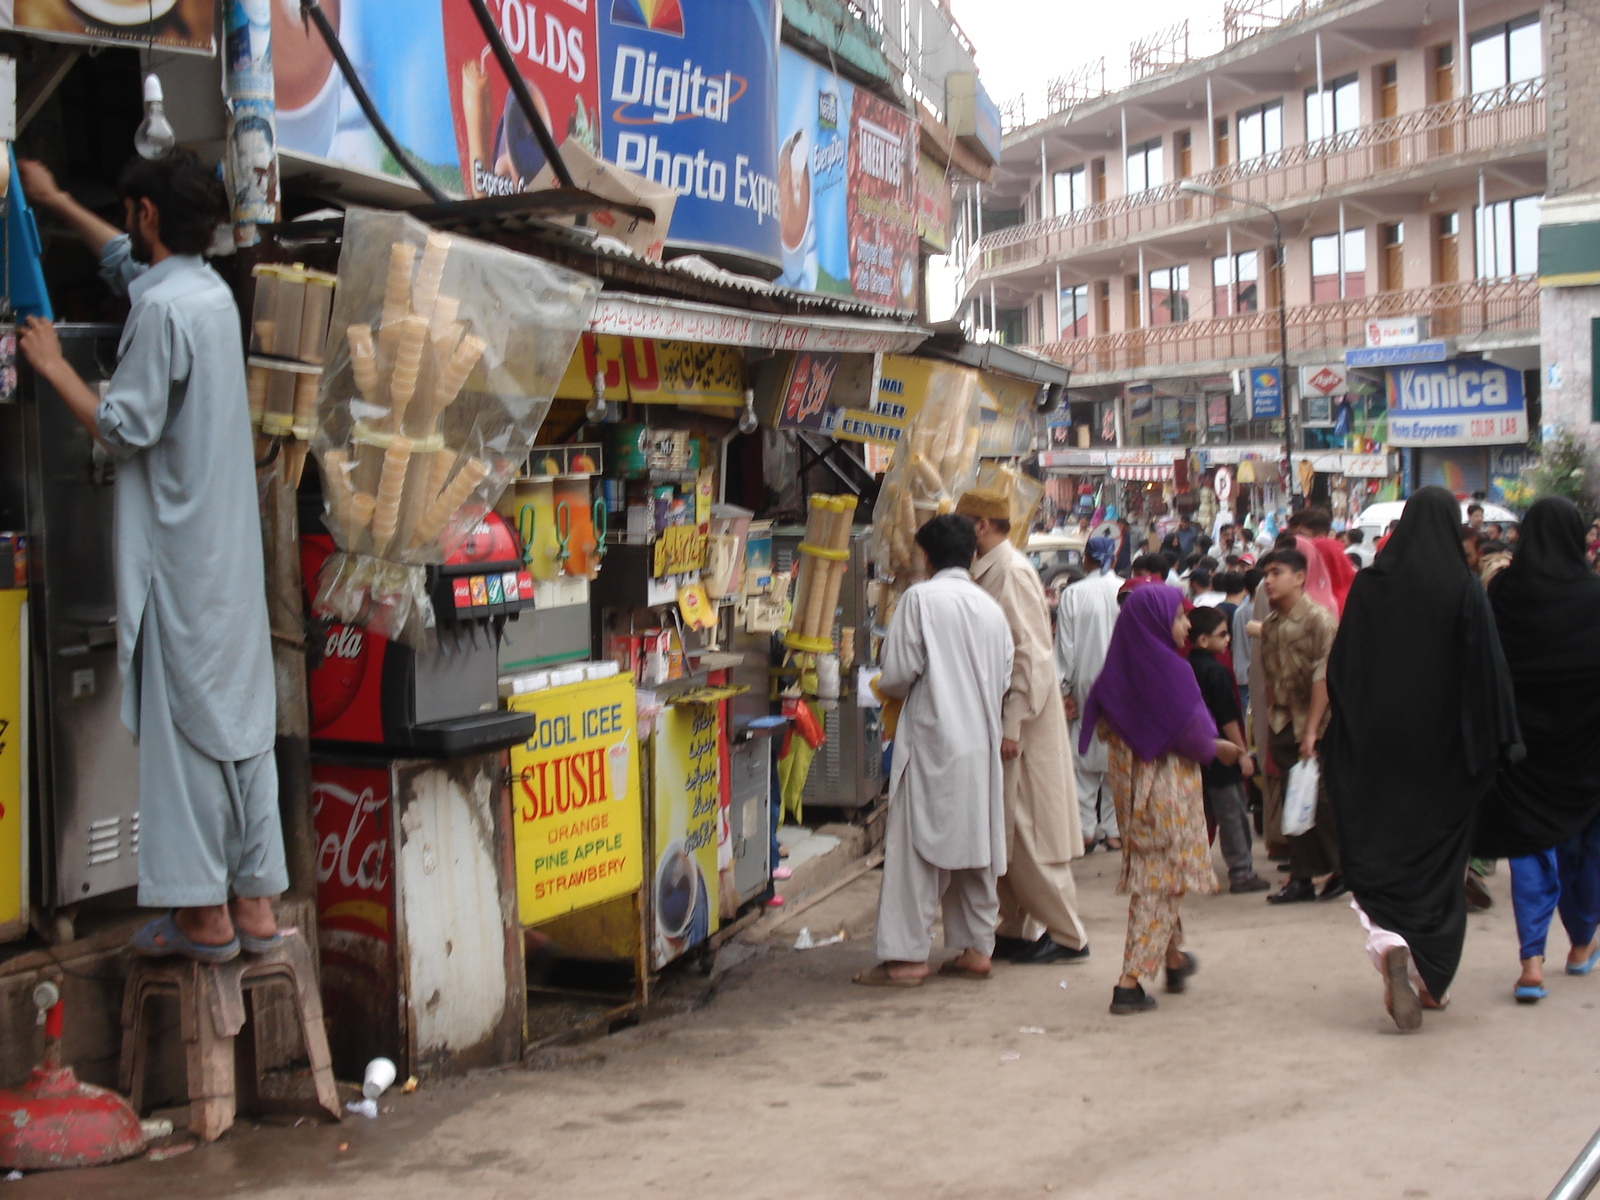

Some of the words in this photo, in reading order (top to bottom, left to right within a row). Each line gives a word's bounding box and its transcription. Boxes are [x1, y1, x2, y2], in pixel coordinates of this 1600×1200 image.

[499, 0, 586, 83] OLDS
[610, 45, 733, 124] Digital
[474, 159, 515, 198] Express
[615, 131, 726, 203] Photo
[1313, 374, 1340, 388] Agfa
[1400, 364, 1508, 411] Konica
[1412, 421, 1457, 441] Express
[1470, 418, 1495, 438] COLOR
[1500, 416, 1517, 436] LAB
[324, 624, 363, 659] ola
[582, 703, 623, 740] ICEE
[520, 747, 608, 824] SLUSH
[547, 812, 609, 846] ORANGE
[534, 849, 570, 875] PINE
[573, 833, 623, 864] APPLE
[534, 856, 628, 900] STRAWBERY
